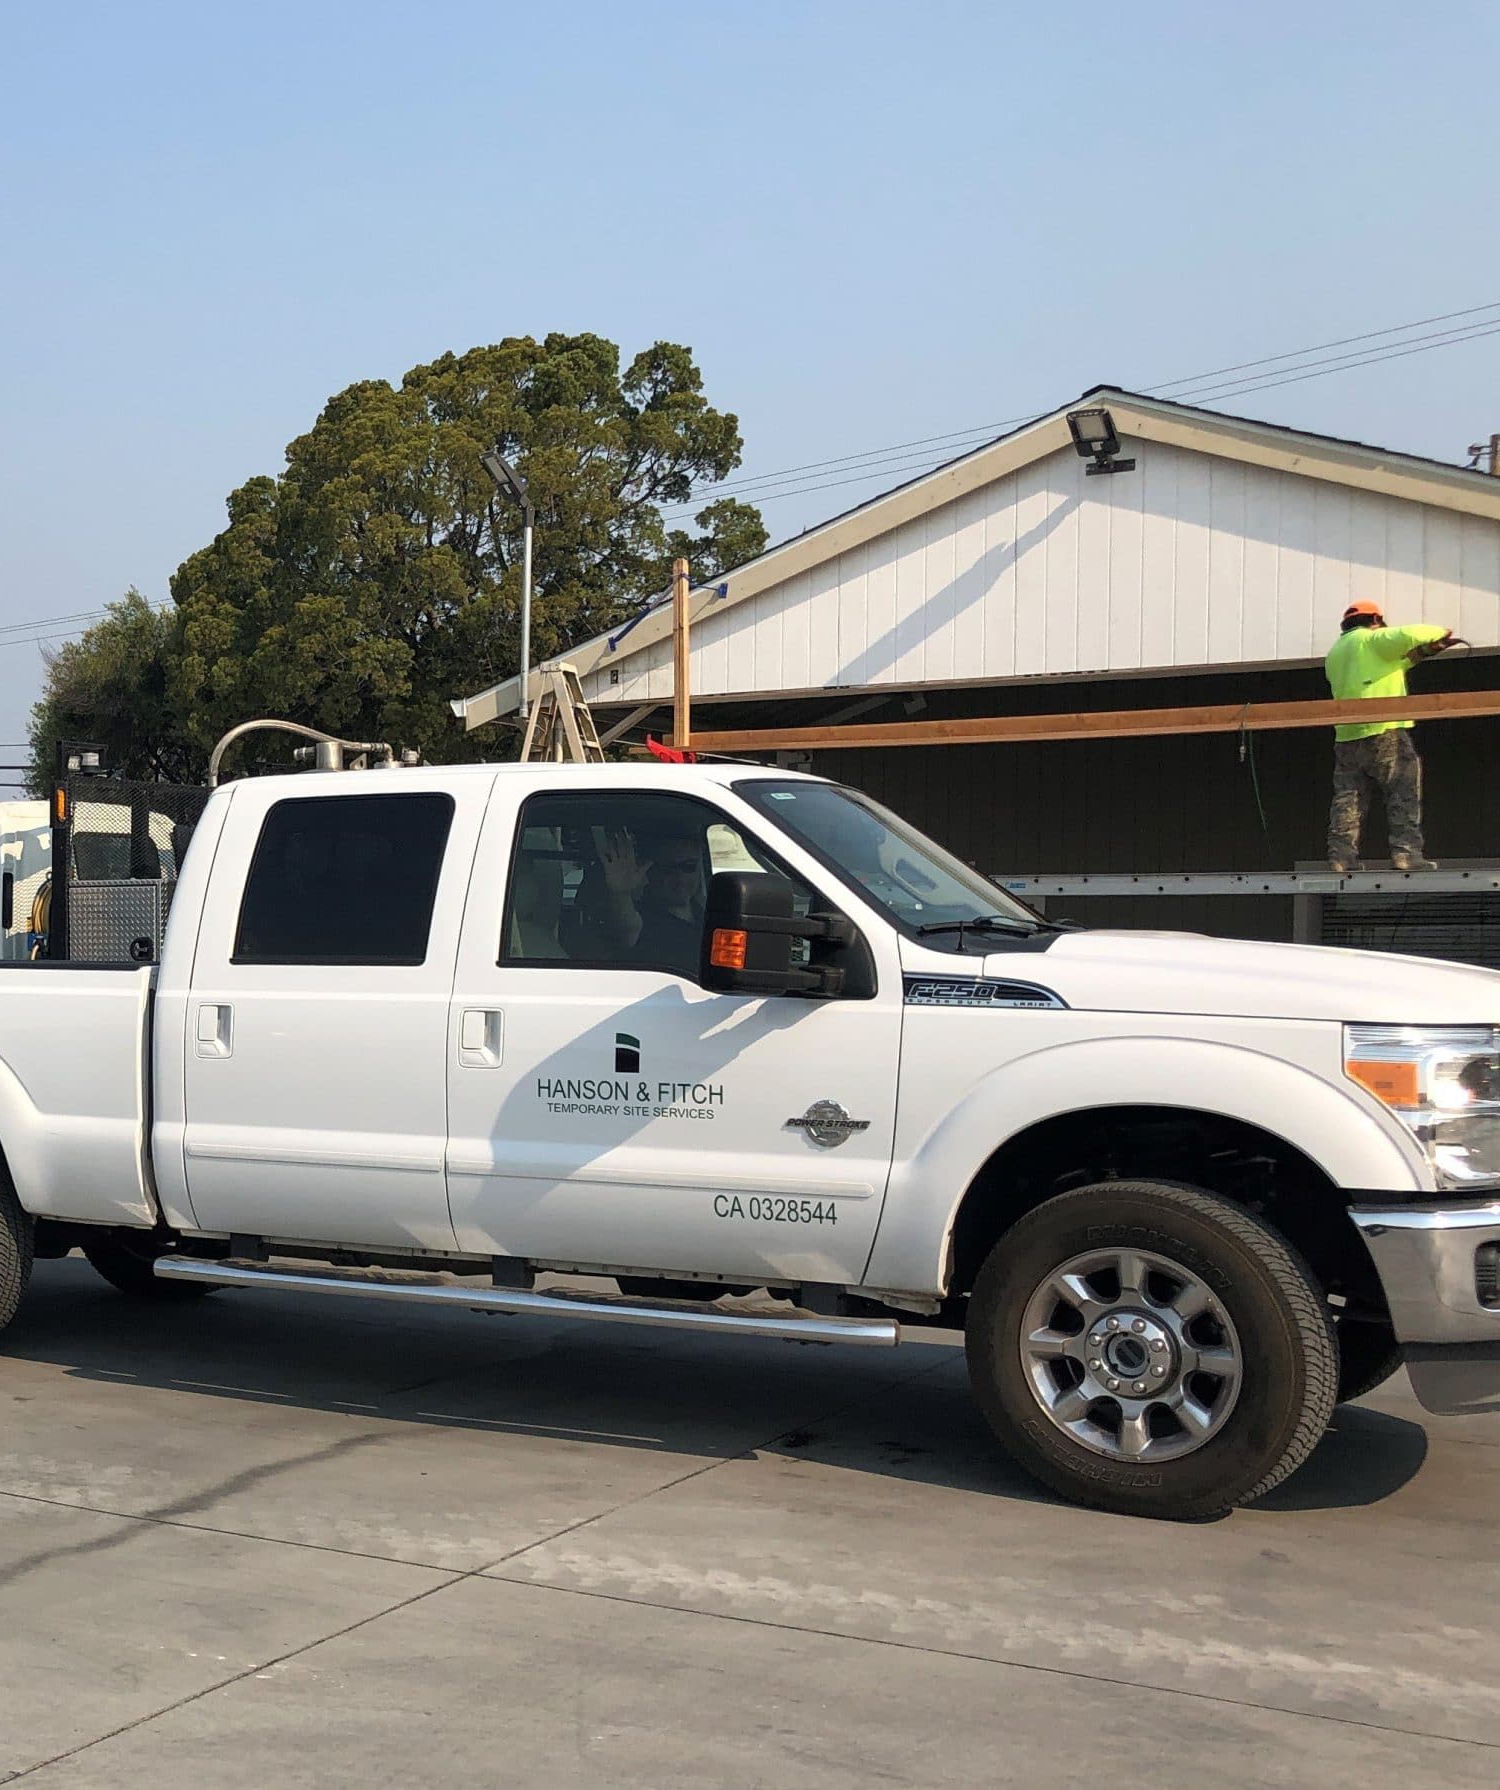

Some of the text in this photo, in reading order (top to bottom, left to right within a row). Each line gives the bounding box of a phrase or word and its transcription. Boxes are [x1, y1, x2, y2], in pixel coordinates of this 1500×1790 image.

[537, 1078, 724, 1105] HANSON & FITCH
[547, 1102, 715, 1120] TEMPORARY SITE SERVICES
[786, 1118, 871, 1129] POWER STROKE
[713, 1194, 838, 1225] CA 0328544
